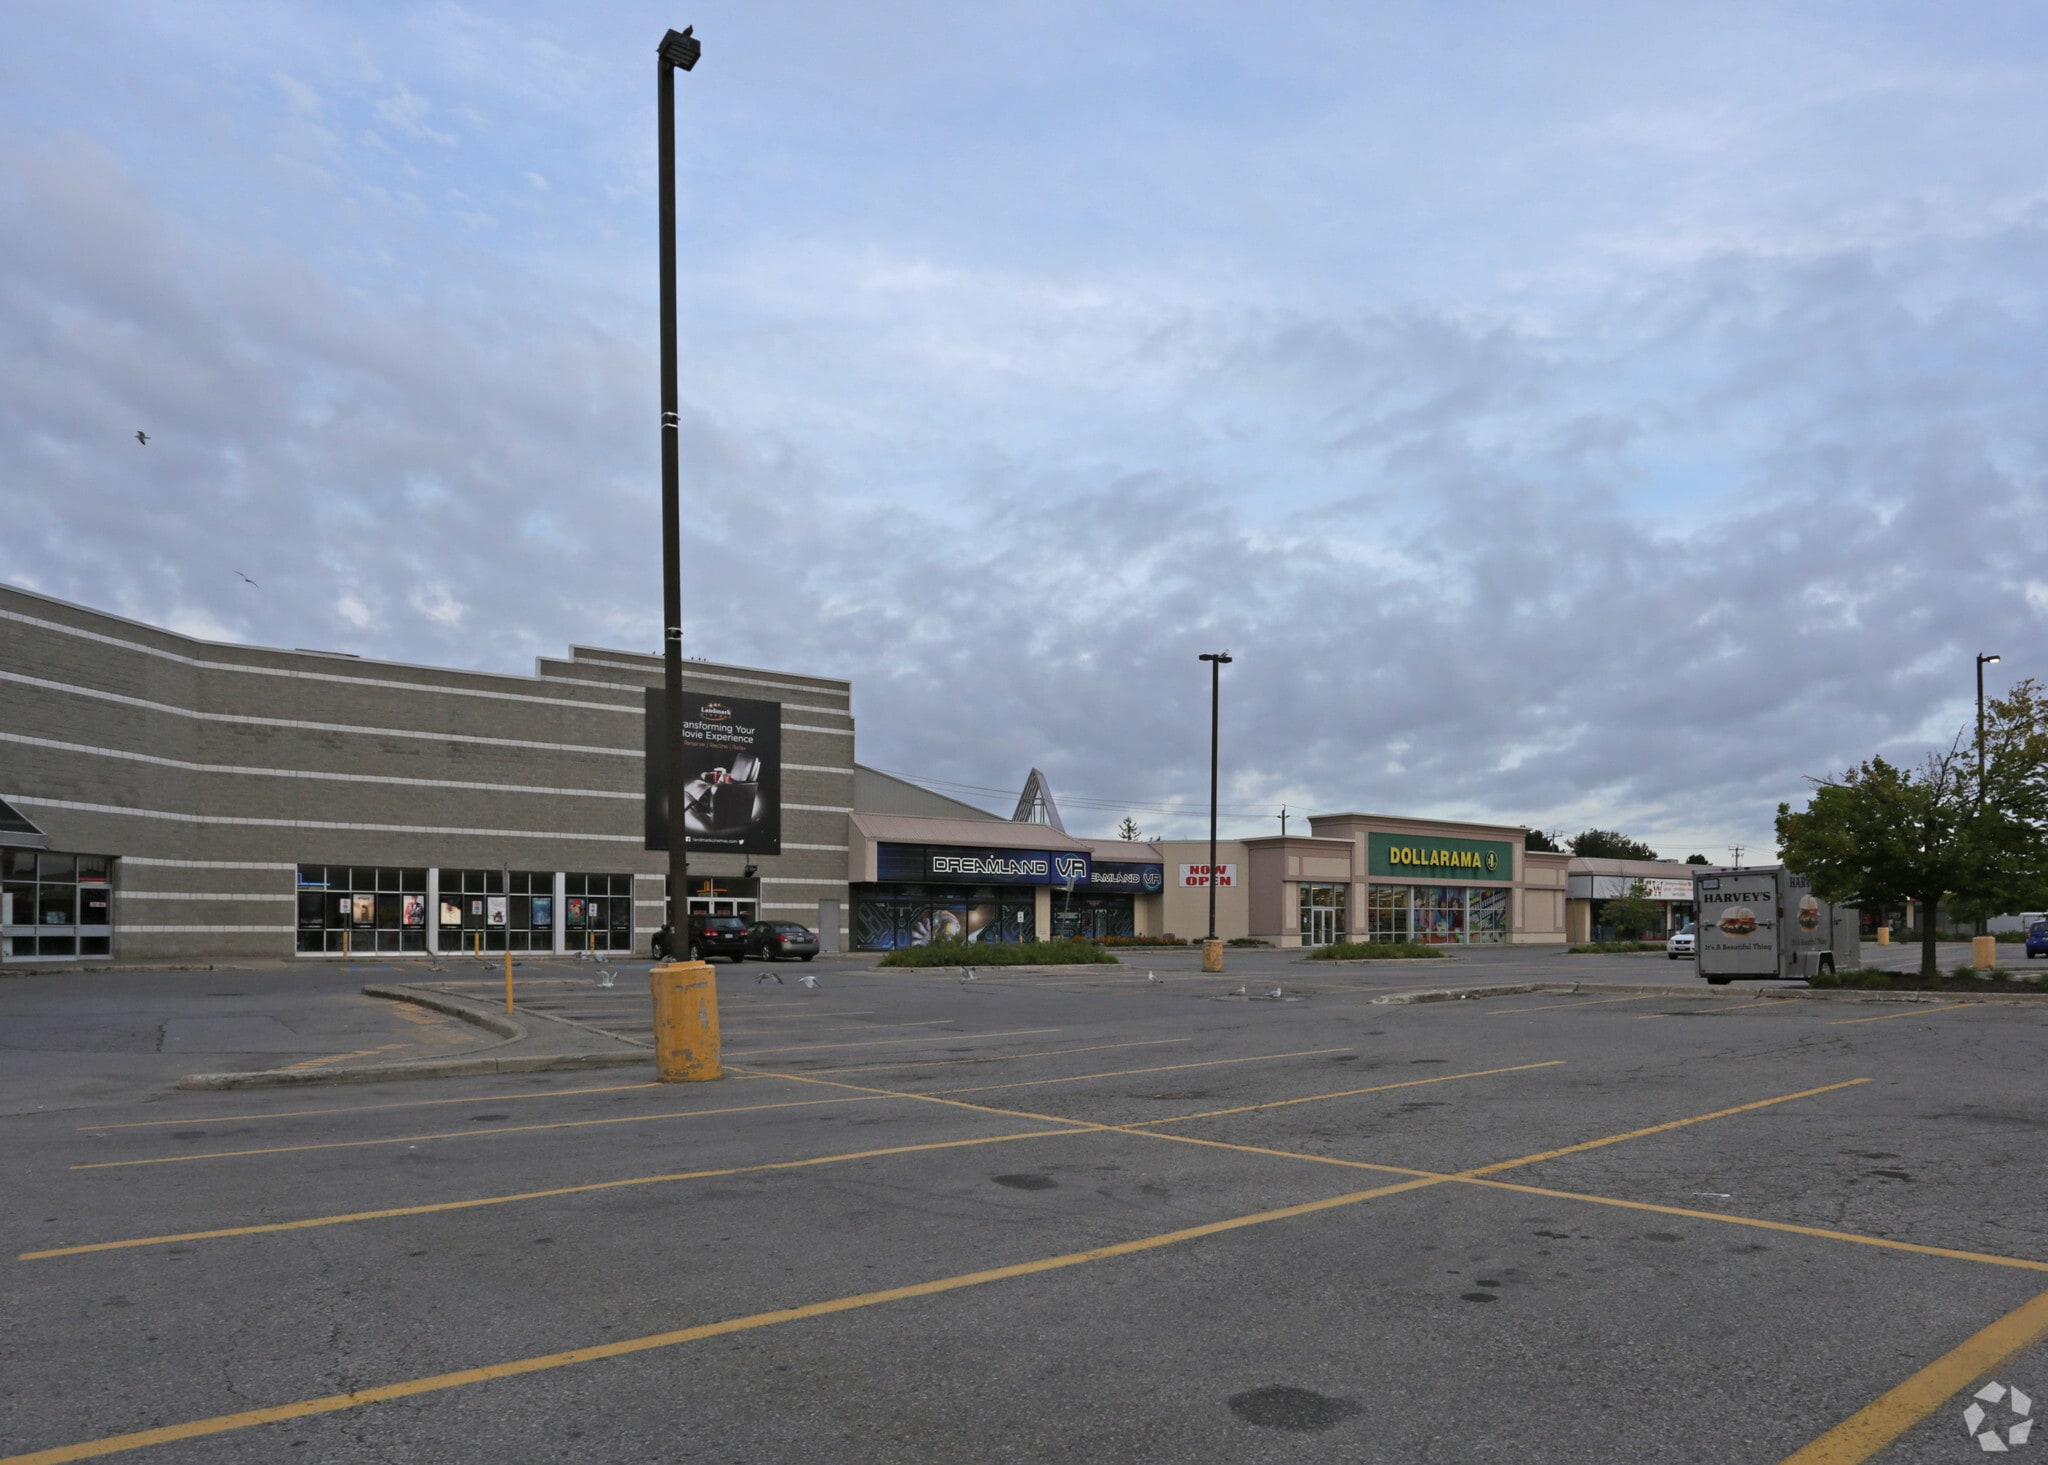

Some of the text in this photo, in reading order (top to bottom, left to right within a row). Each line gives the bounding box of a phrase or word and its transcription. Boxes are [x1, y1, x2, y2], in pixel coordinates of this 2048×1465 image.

[701, 706, 731, 715] Landmark
[682, 720, 756, 735] ansforming Your
[682, 729, 754, 744] ovie Experience
[1390, 847, 1481, 868] DOLLARAMA
[933, 856, 1086, 878] DREAMLAND VR
[1190, 865, 1227, 875] NOW
[1090, 872, 1161, 885] EAMLAND VR
[1186, 876, 1231, 886] OPN
[1704, 891, 1771, 903] HARVEY'S
[1722, 943, 1752, 951] Beautiful
[1752, 942, 1772, 951] Thing
